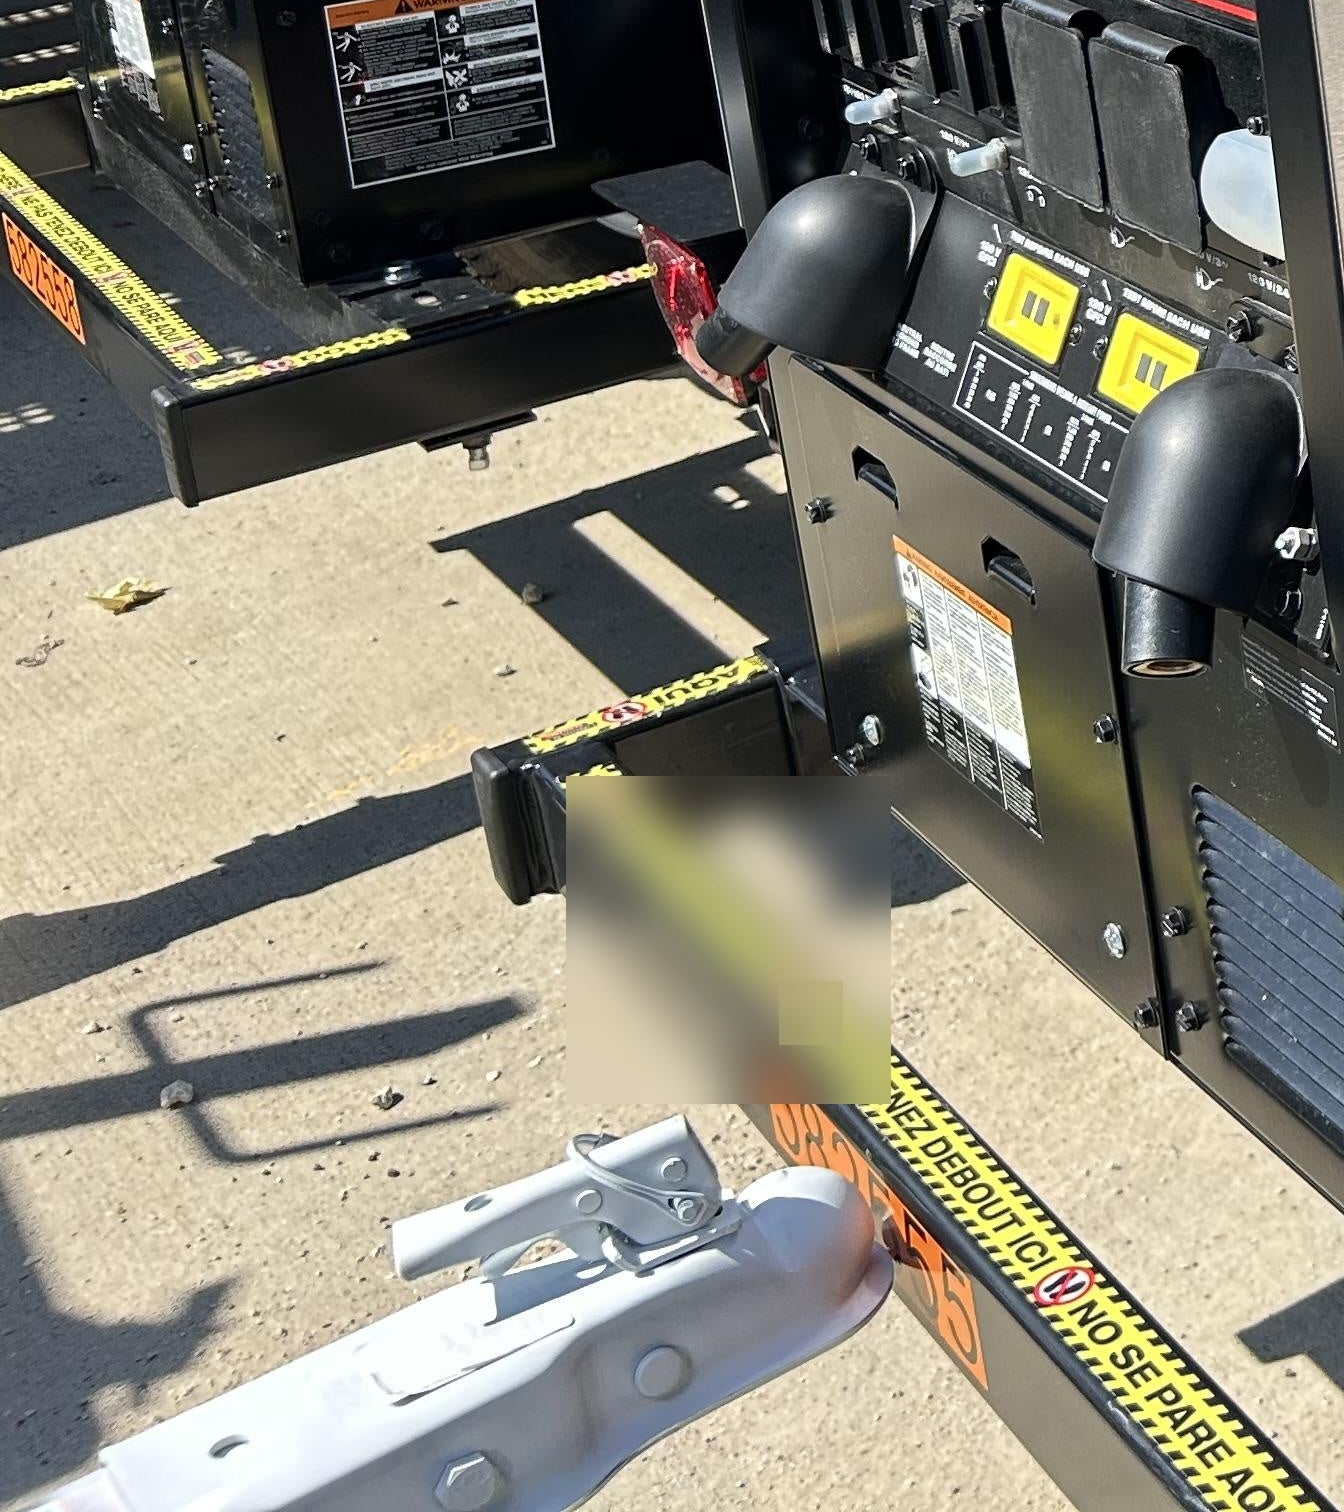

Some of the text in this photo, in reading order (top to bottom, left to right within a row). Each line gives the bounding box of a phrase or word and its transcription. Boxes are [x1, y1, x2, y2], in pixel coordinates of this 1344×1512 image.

[6, 220, 81, 336] 582558
[46, 215, 75, 238] TENEZ
[63, 235, 104, 264] DEBOUT
[112, 281, 181, 343] NO SE PARE AQUI
[653, 665, 740, 706] AQUI
[884, 1089, 1057, 1273] NEZ DEBOUT ICI
[1068, 1298, 1288, 1512] NO SE PARE AQ
